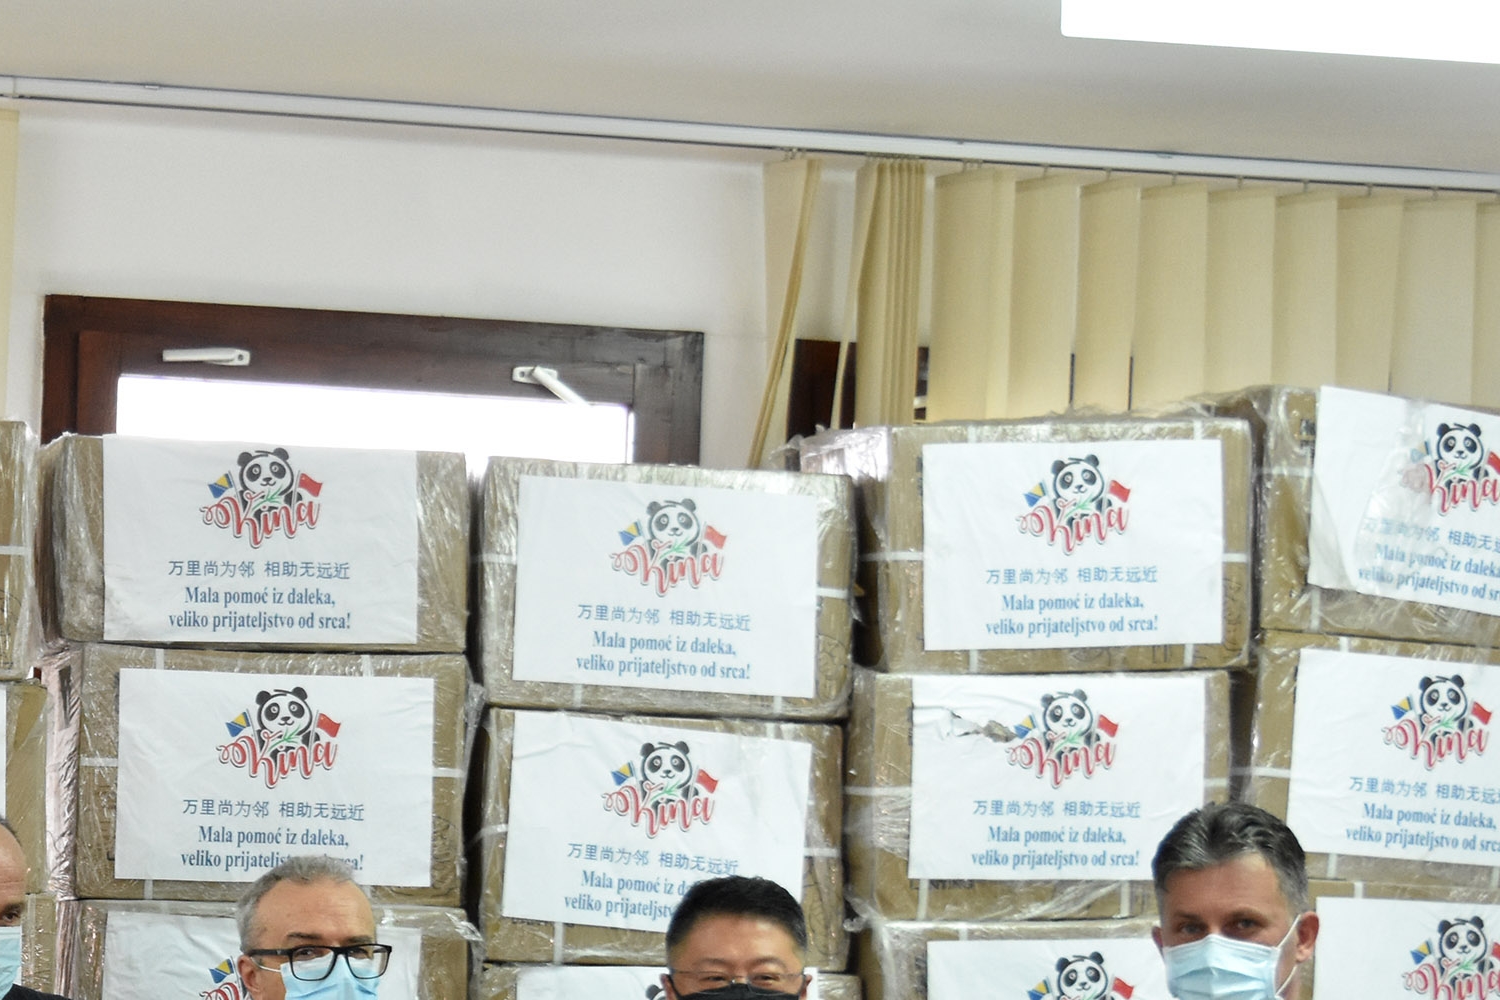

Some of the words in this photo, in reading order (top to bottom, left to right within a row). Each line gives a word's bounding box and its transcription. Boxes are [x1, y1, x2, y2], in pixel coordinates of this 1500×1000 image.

[184, 586, 219, 604] Mala
[223, 585, 269, 609] pomoć
[272, 586, 284, 604] iz
[287, 587, 336, 608] daleka,
[1001, 593, 1035, 612] Mala
[1037, 591, 1081, 616] pomoć
[1083, 591, 1096, 610] iz
[1098, 591, 1145, 612] daleka,
[168, 610, 209, 628] veliko
[212, 611, 295, 633] prijateljstvo
[298, 611, 315, 629] od
[318, 611, 352, 629] srca!
[985, 617, 1025, 636] veliko
[1027, 615, 1107, 639] prijateljstvo
[1108, 614, 1126, 633] od
[1127, 613, 1160, 632] srca!
[591, 629, 626, 649] Mala
[628, 633, 673, 654] pomoć
[675, 634, 688, 653] iz
[690, 635, 737, 659] daleka,
[575, 653, 615, 672] veliko
[617, 656, 698, 680] prijateljstvo
[699, 660, 717, 678] od
[719, 662, 752, 680] srca!
[1362, 802, 1395, 821] Mala
[1396, 806, 1439, 827] pomoć
[1440, 807, 1452, 826] iz
[1453, 809, 1497, 833] daleka,
[198, 825, 233, 843] Mala
[236, 826, 282, 848] pomoć
[285, 827, 297, 845] iz
[301, 827, 349, 850] daleka,
[987, 825, 1021, 843] Mala
[1022, 824, 1066, 848] pomoć
[1068, 825, 1080, 843] iz
[1082, 825, 1127, 847] daleka,
[1346, 825, 1383, 844] veliko
[1385, 828, 1460, 852] prijateljstvo
[1461, 833, 1478, 851] od
[180, 849, 221, 867] veliko
[971, 848, 1010, 867] veliko
[1011, 849, 1090, 871] prijateljstvo
[1090, 849, 1108, 867] od
[1110, 848, 1141, 867] srca!
[580, 869, 614, 889] Mala
[616, 875, 661, 895] pomoć
[663, 876, 676, 895] iz
[563, 892, 602, 912] veliko
